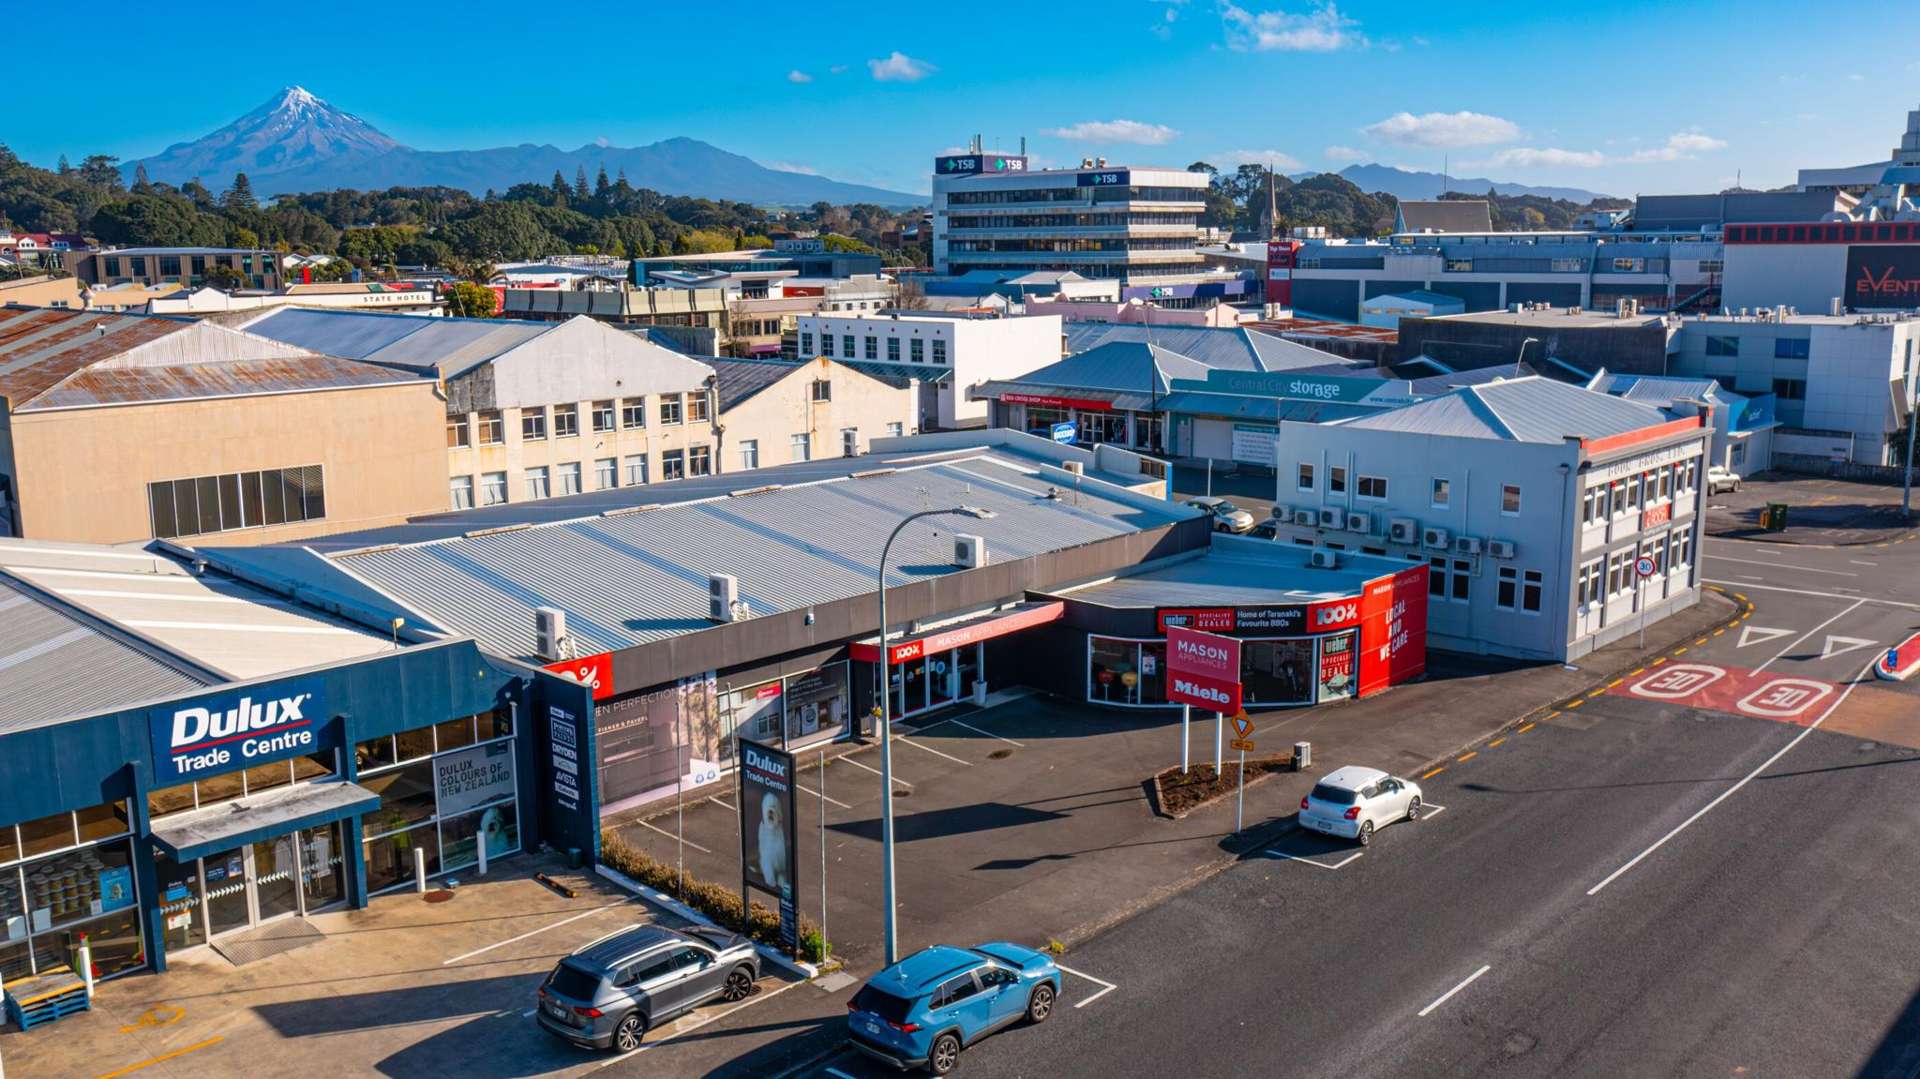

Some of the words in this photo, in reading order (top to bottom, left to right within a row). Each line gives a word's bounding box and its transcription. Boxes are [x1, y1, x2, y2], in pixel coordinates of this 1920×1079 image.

[957, 160, 975, 169] TSB
[1006, 160, 1022, 170] TSB
[1102, 174, 1117, 183] TSB
[1856, 266, 1920, 292] EVENT
[1231, 378, 1265, 391] Central
[1268, 379, 1288, 392] City
[1290, 379, 1340, 398] storage
[1639, 560, 1652, 571] 30
[1237, 610, 1257, 618] Home
[1259, 610, 1266, 618] of
[1316, 604, 1358, 625] 100%
[1385, 600, 1406, 624] LOCAL
[1237, 619, 1269, 628] Favourite
[1388, 618, 1402, 639] AND
[937, 631, 970, 647] MASON
[1380, 643, 1391, 661] WE
[1392, 630, 1408, 652] CARE
[896, 644, 920, 659] 100%
[1177, 640, 1228, 660] MASON
[1651, 671, 1704, 690] 30
[613, 687, 678, 712] PERFECTION
[1174, 680, 1230, 704] Miele
[1758, 686, 1810, 708] 30
[171, 694, 305, 748] Dulux
[172, 748, 230, 774] Trade
[242, 730, 312, 758] Centre
[440, 760, 473, 777] DULUX
[746, 750, 785, 776] Dulux
[440, 767, 487, 787] COLOURS
[490, 762, 503, 774] OF
[441, 784, 461, 798] NEW
[465, 771, 510, 791] ZEALAND
[746, 770, 764, 784] Trade
[765, 777, 787, 791] Centre
